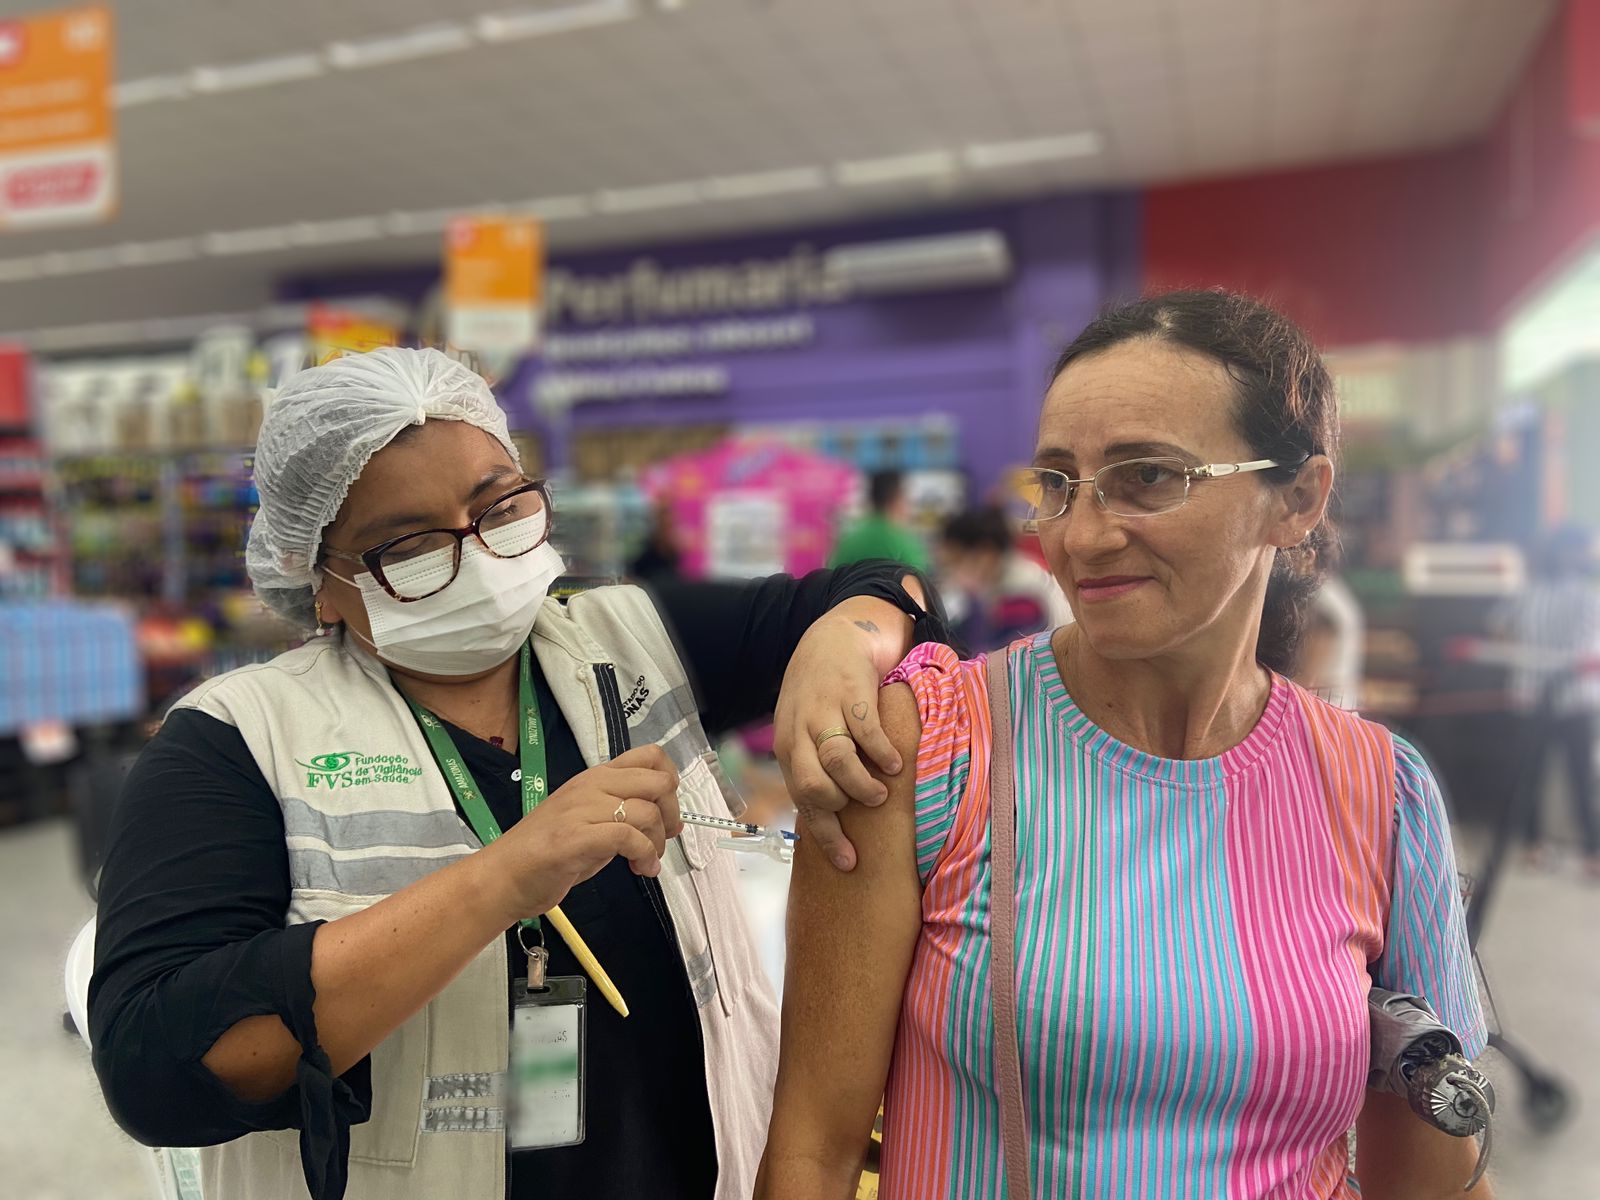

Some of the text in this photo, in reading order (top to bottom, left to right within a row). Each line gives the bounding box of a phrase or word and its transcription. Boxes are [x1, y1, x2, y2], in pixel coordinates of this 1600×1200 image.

[528, 716, 539, 746] AMAZONAS
[355, 755, 409, 767] Fundação
[355, 765, 423, 777] de Vigilância
[446, 758, 469, 790] AMAZONAS
[306, 771, 353, 790] FVS
[354, 774, 409, 786] em Saúde
[525, 775, 535, 792] FVS
